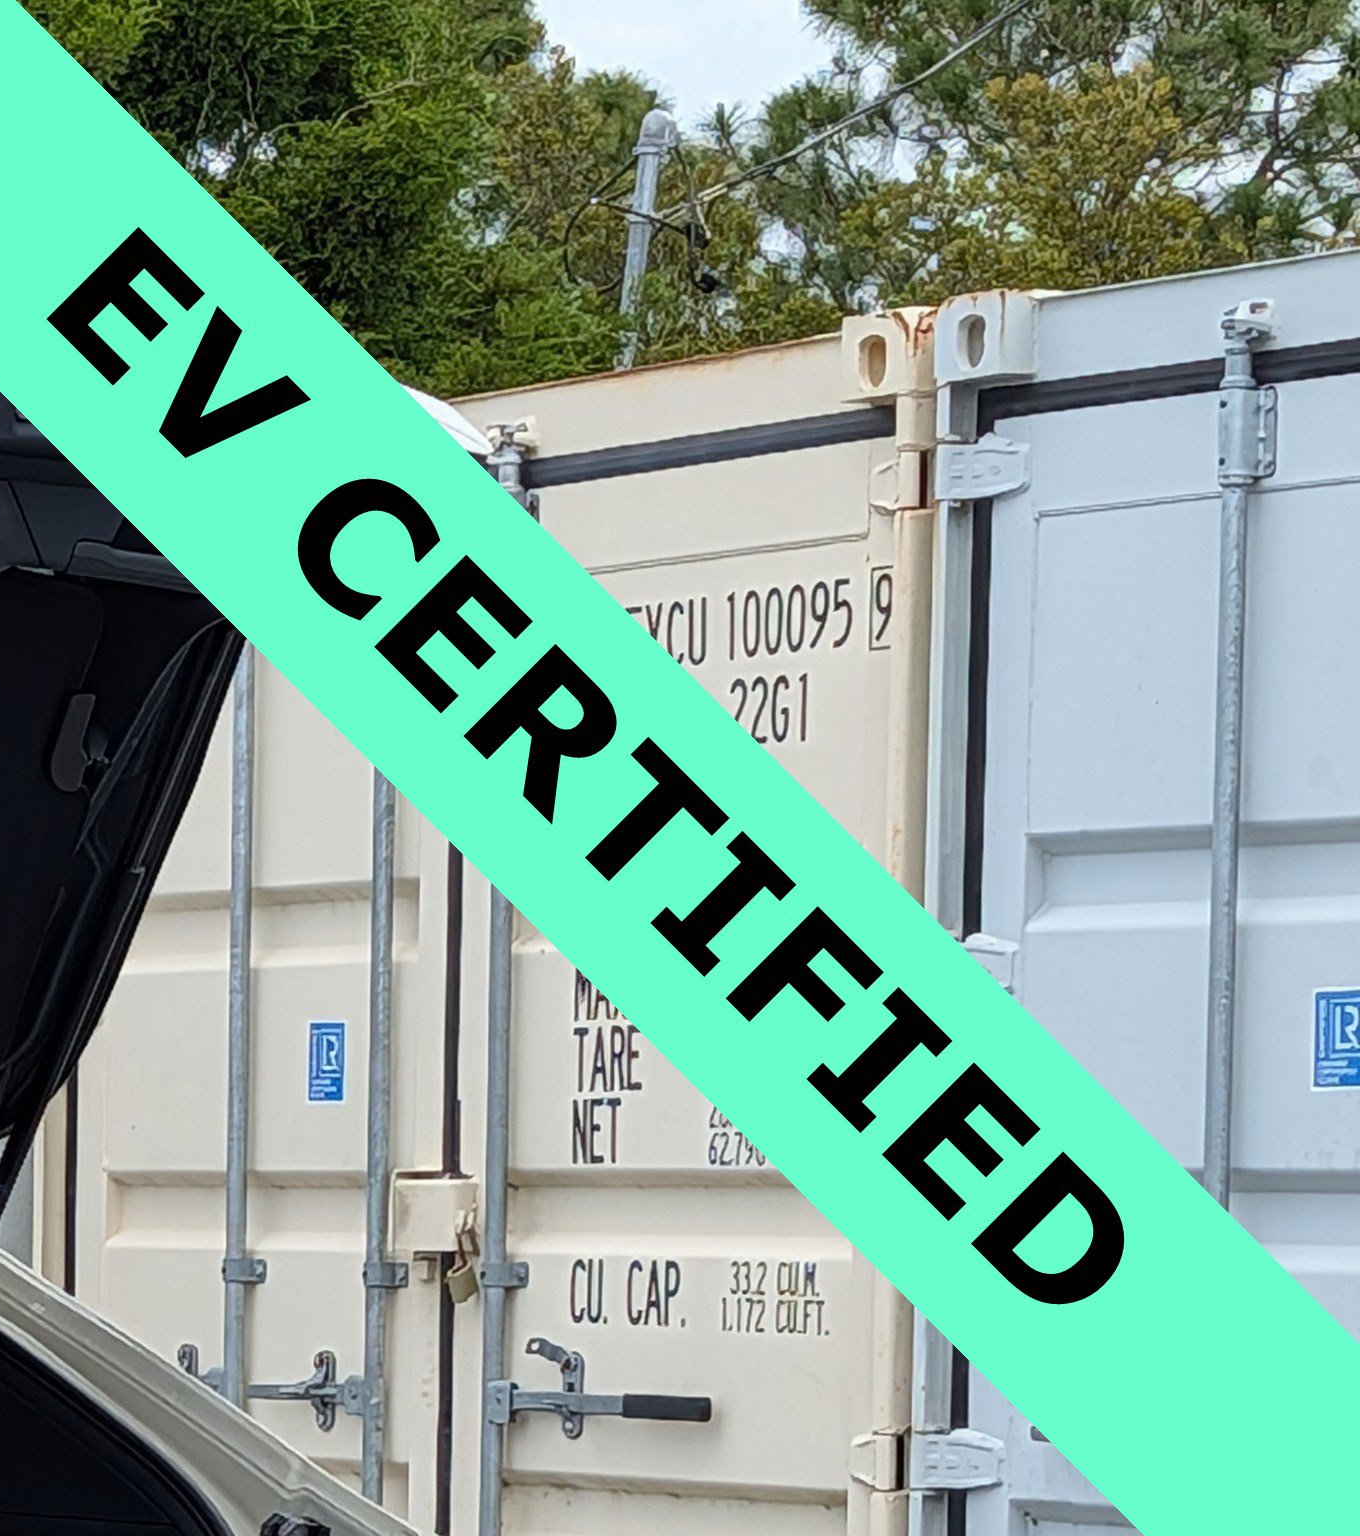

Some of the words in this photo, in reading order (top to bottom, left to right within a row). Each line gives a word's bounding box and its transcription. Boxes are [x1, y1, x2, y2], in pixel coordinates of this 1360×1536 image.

[727, 578, 853, 660] 100095
[730, 673, 808, 743] 22G1
[573, 1025, 642, 1092] TARE
[572, 1097, 621, 1164] NET
[570, 1258, 607, 1324] CU.
[627, 1260, 686, 1327] CAP.
